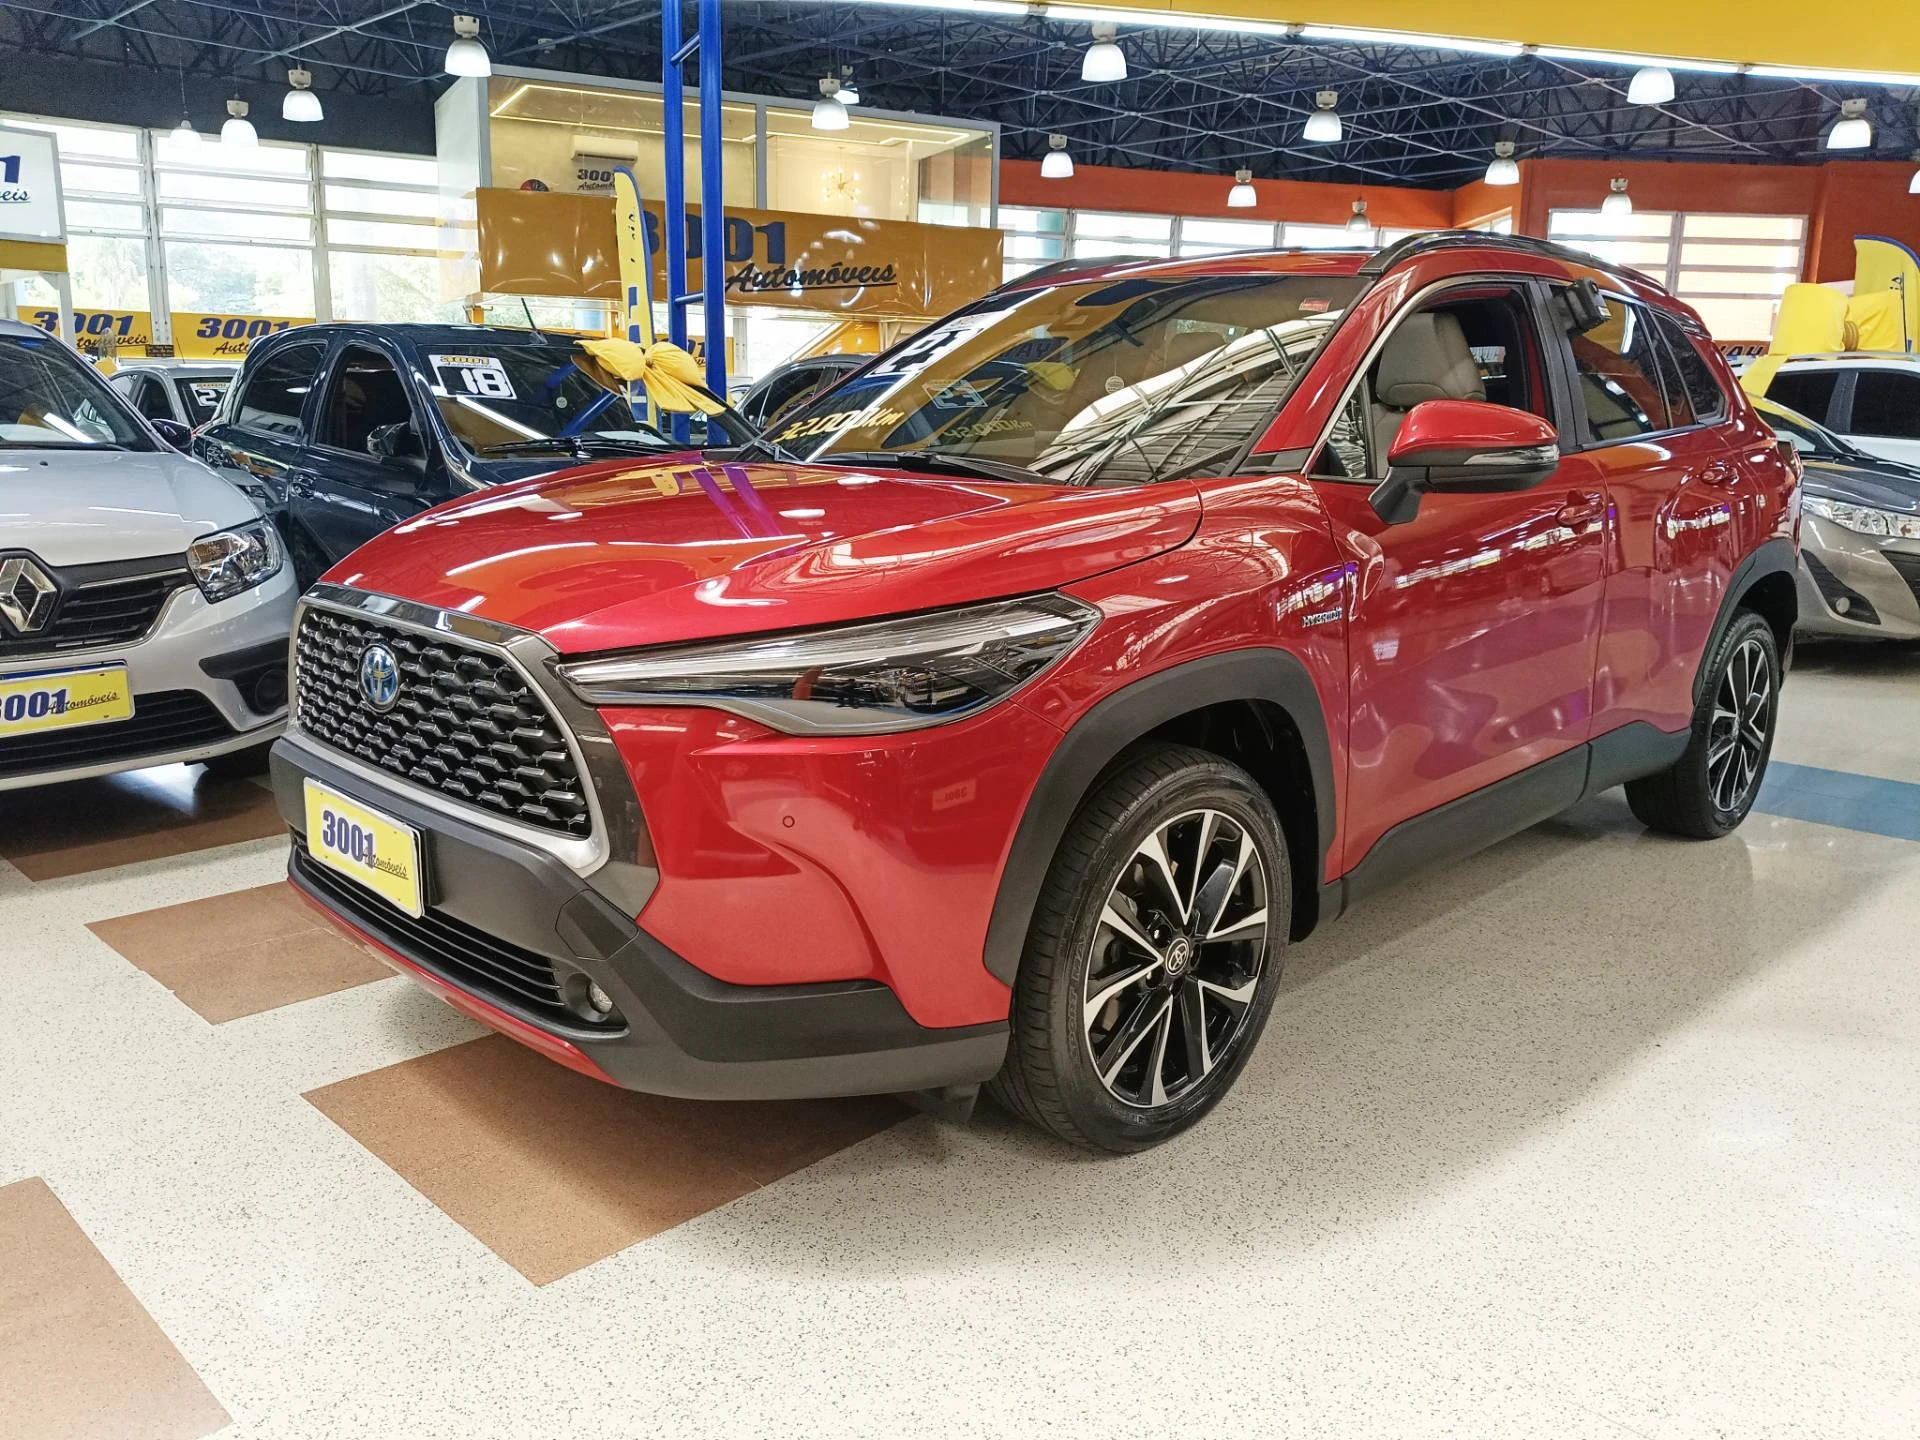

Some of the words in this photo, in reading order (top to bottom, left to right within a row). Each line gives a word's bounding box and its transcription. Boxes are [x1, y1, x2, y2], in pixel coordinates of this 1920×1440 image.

[460, 368, 512, 397] 18
[0, 688, 67, 721] 001
[322, 810, 374, 869] 3001
